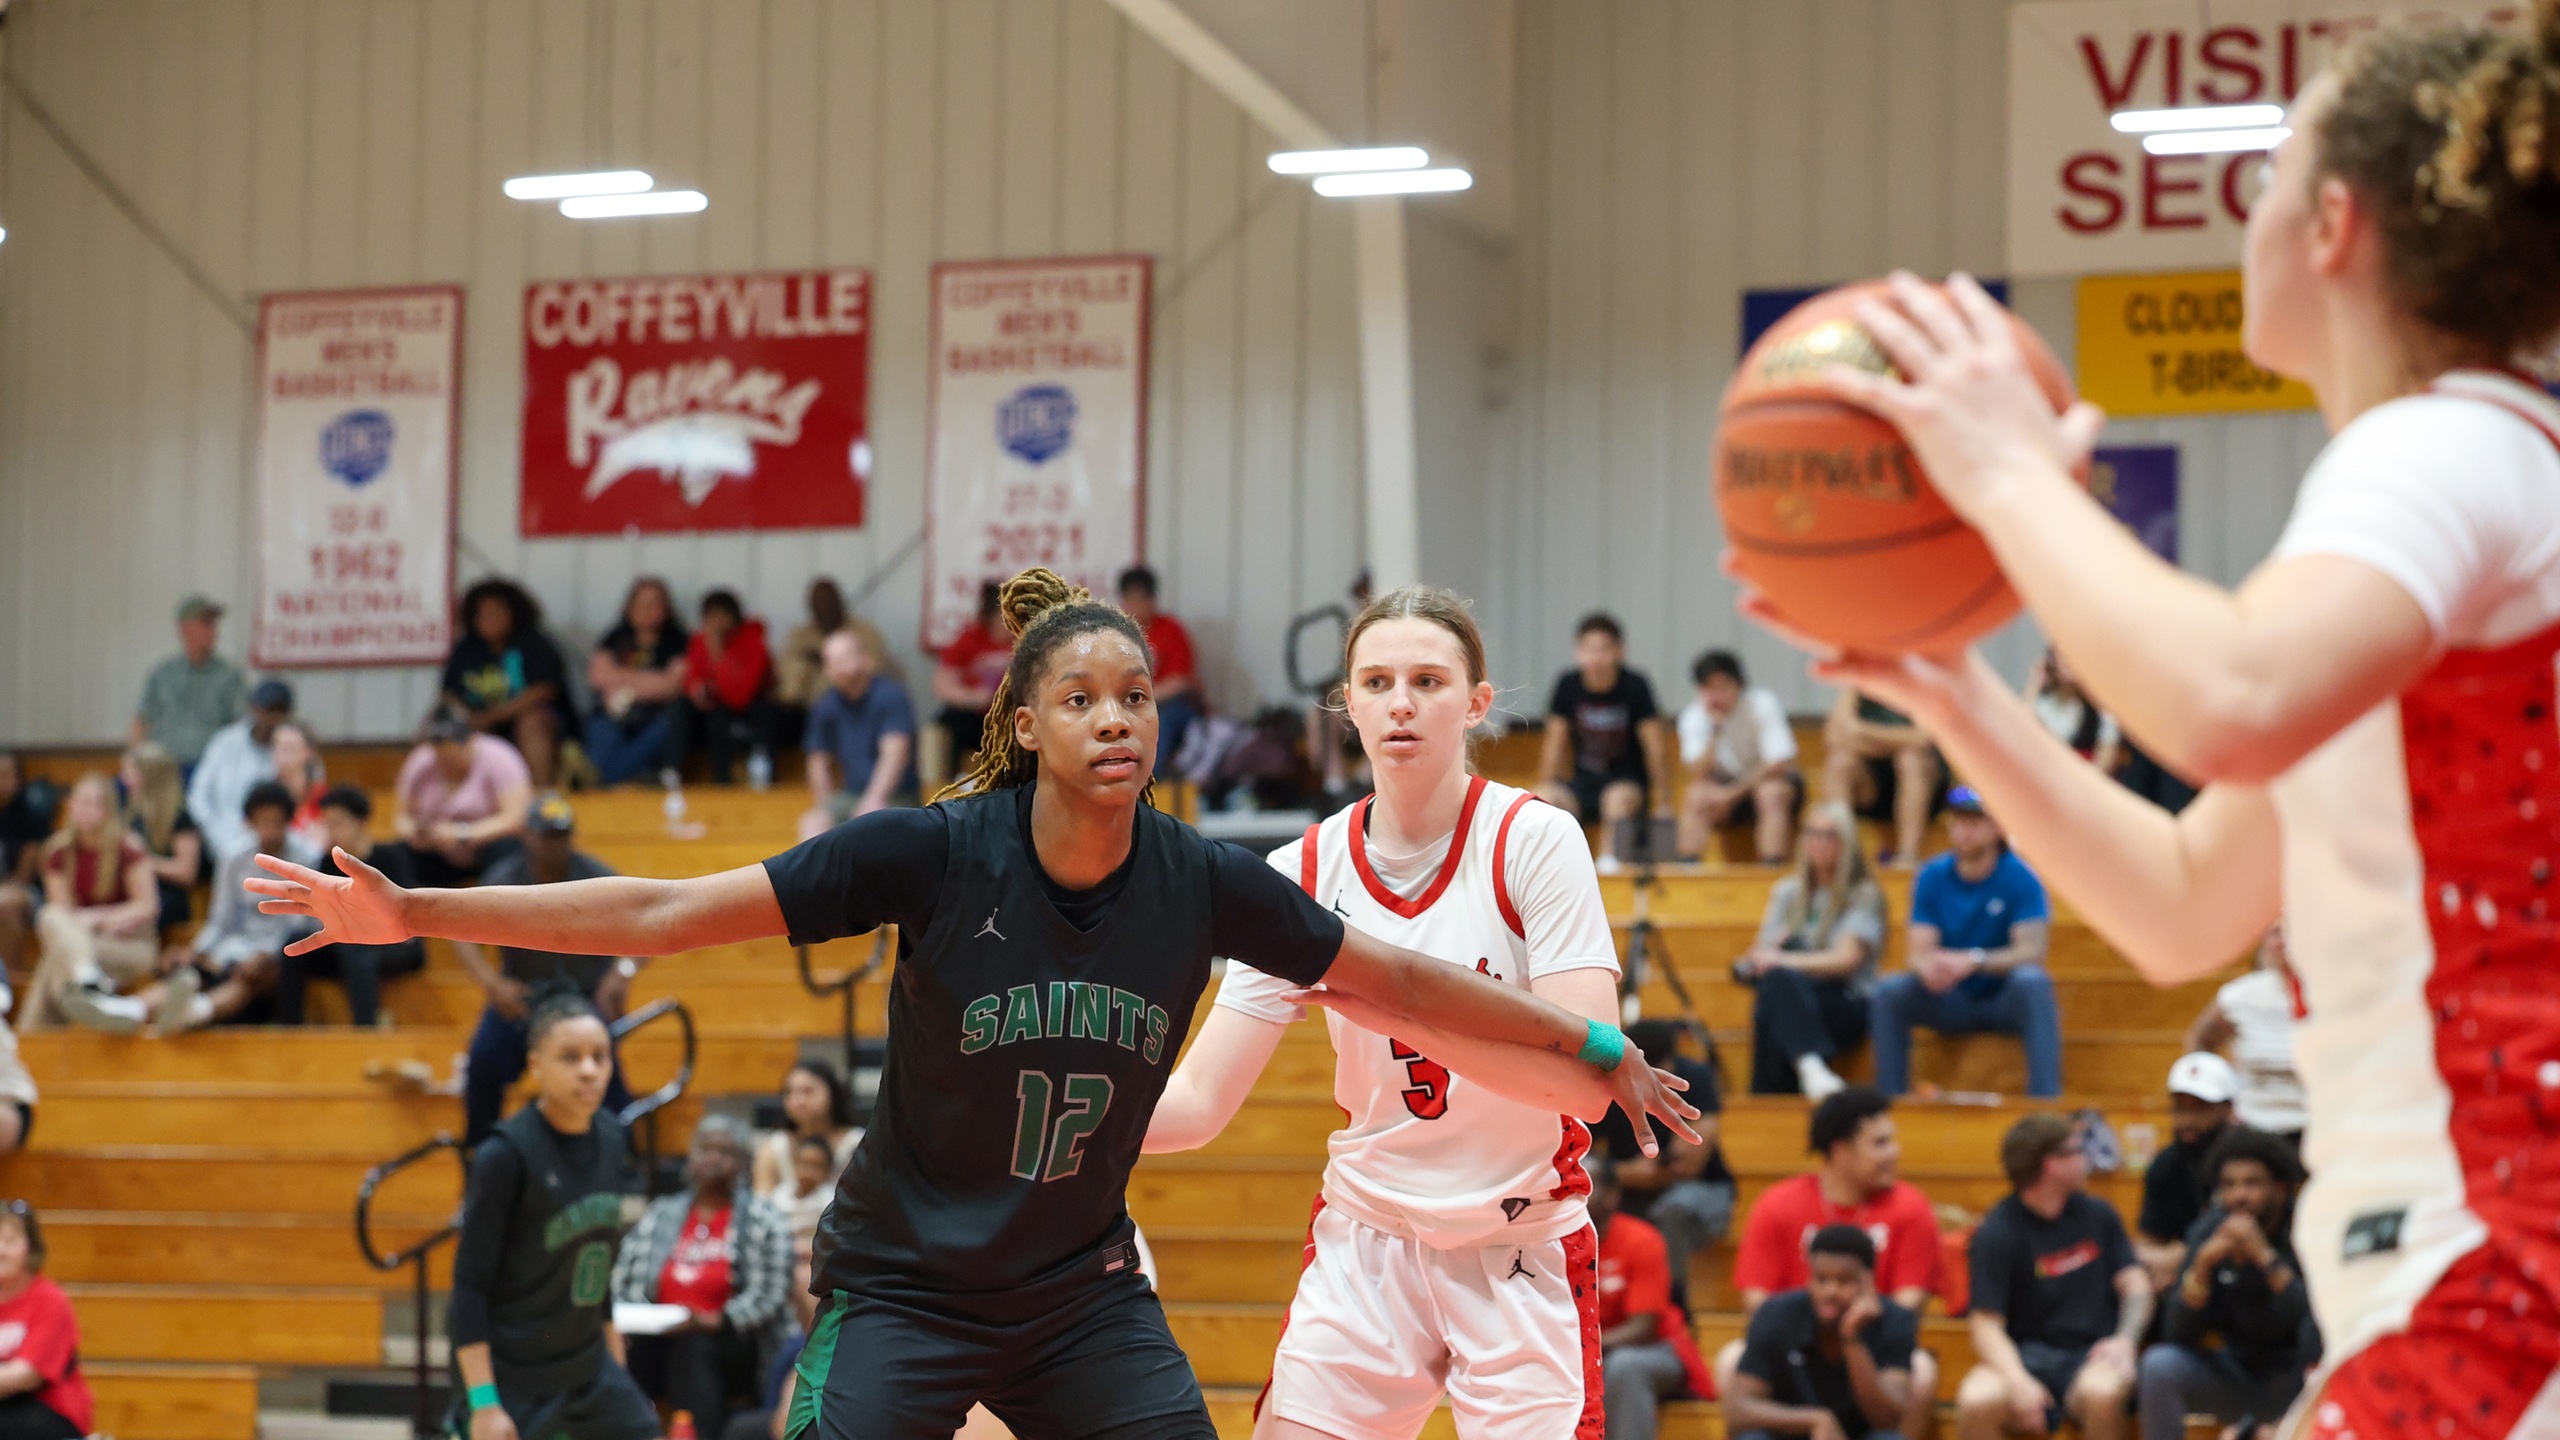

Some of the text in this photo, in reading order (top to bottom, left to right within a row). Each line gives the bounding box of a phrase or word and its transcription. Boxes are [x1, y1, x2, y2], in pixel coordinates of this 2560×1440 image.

[528, 271, 866, 348] COFFEYVILLE
[566, 354, 823, 468] Ravens
[960, 981, 1169, 1065] SAINTS
[1389, 1037, 1451, 1121] 3
[1010, 1069, 1114, 1183] 12
